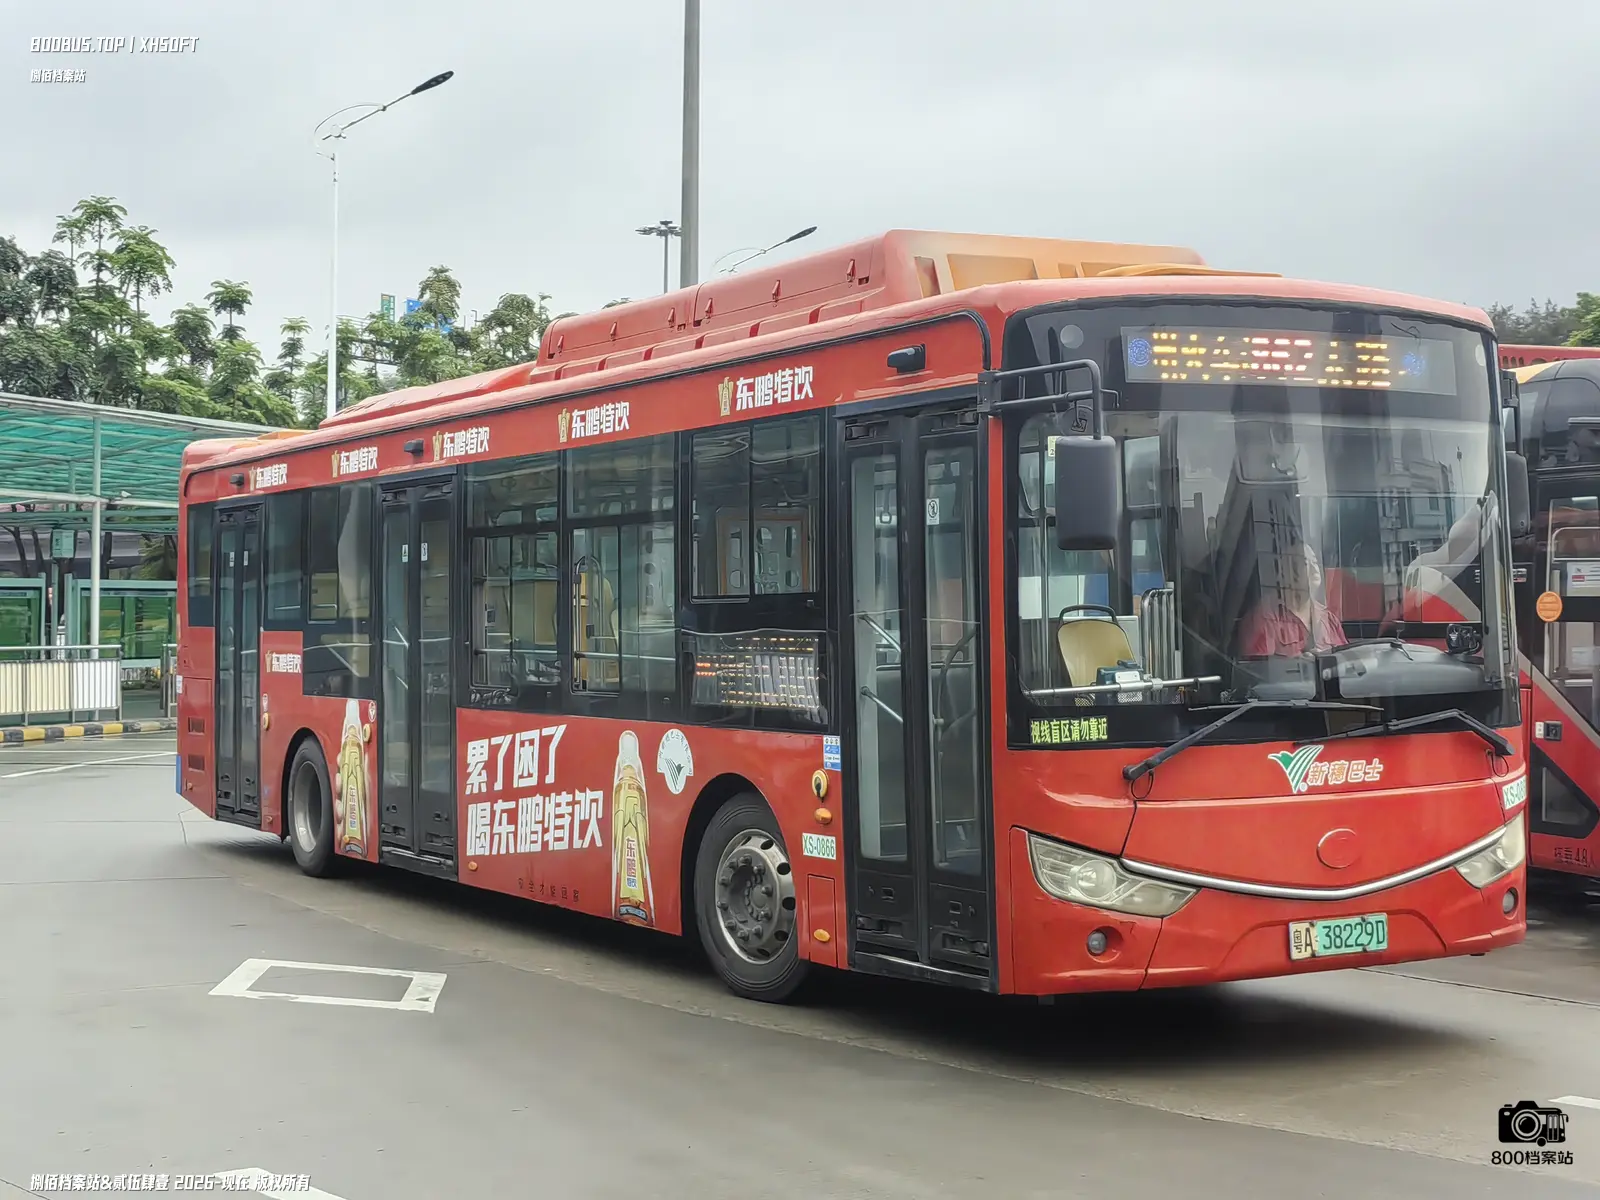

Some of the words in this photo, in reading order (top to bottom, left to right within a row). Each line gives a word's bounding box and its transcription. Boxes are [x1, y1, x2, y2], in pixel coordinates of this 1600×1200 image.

[736, 365, 814, 411] 东鹏特饮
[571, 401, 630, 438] 东鹏特饮
[443, 426, 490, 458] 东鹏特饮
[255, 463, 288, 489] 东鹏特饮
[340, 446, 378, 475] 东鹏特饮
[1031, 717, 1108, 743] 视线盲区请勿靠近
[465, 724, 567, 795] 累了困了
[465, 787, 604, 856] 喝东鹏特饮
[803, 836, 836, 858] XS-0866
